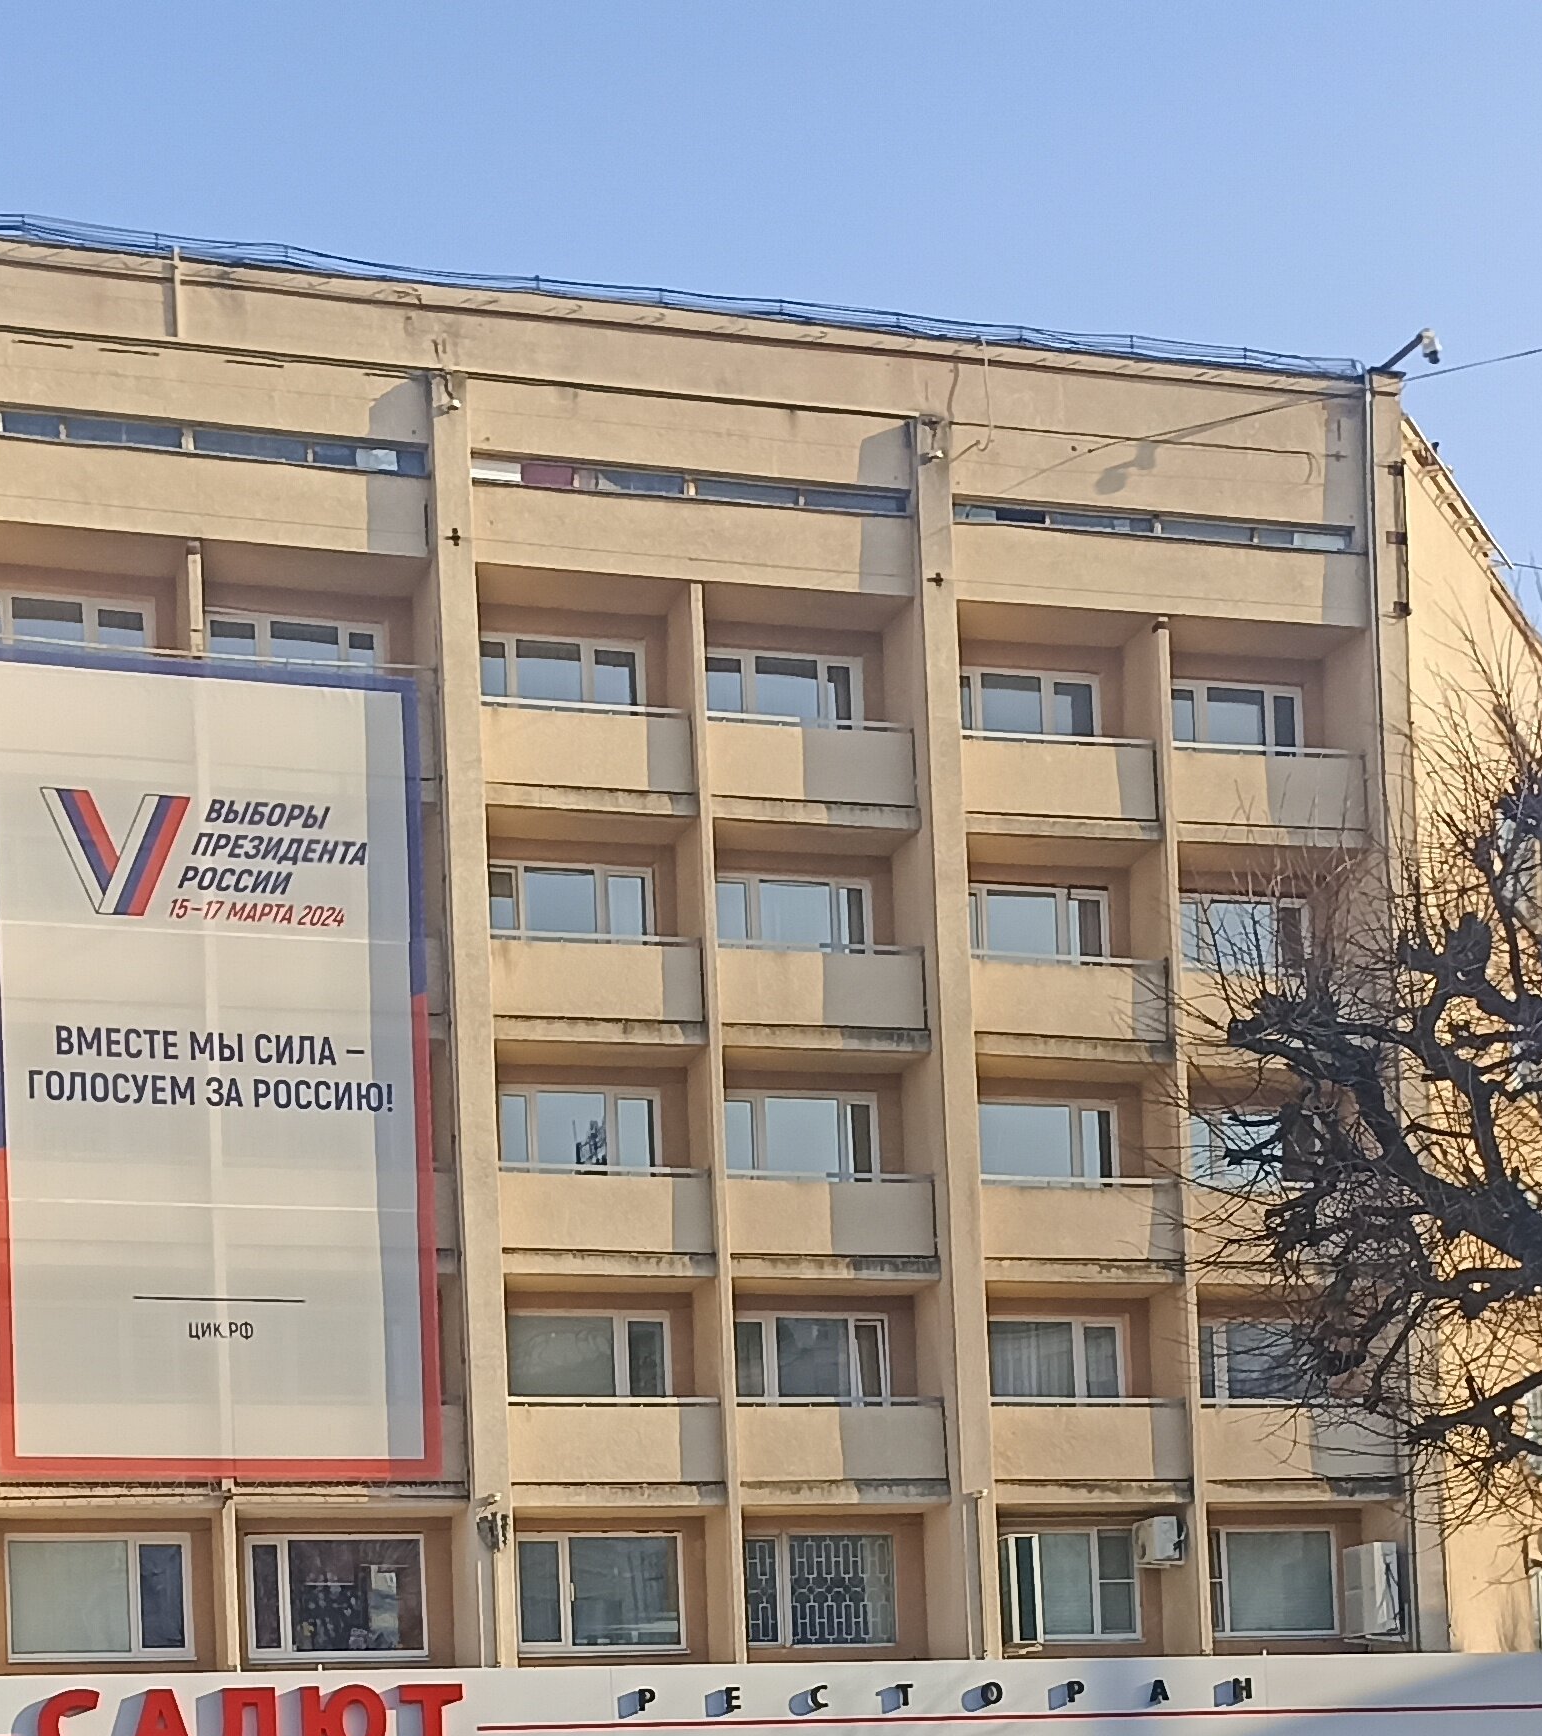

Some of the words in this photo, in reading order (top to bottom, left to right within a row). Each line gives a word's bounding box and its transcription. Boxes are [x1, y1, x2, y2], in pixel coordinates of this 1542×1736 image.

[205, 799, 331, 829] ВЫБОРЫ
[191, 832, 367, 865] ПРЕЗИДЕНТА
[178, 866, 293, 895] РОССИИ
[226, 902, 294, 924] МАРТА
[297, 906, 345, 927] 2024
[55, 1025, 179, 1060] ВМЕСТЕ
[190, 1032, 244, 1063] МЫ
[254, 1034, 337, 1066] СИЛА
[28, 1070, 196, 1106] ГОЛОСУЕМ
[205, 1077, 243, 1108] ЗА
[254, 1080, 394, 1112] РОССИЮ!
[188, 1321, 222, 1341] ЦИК
[229, 1322, 254, 1341] РФ
[637, 1677, 1253, 1712] РЕСТОРАН
